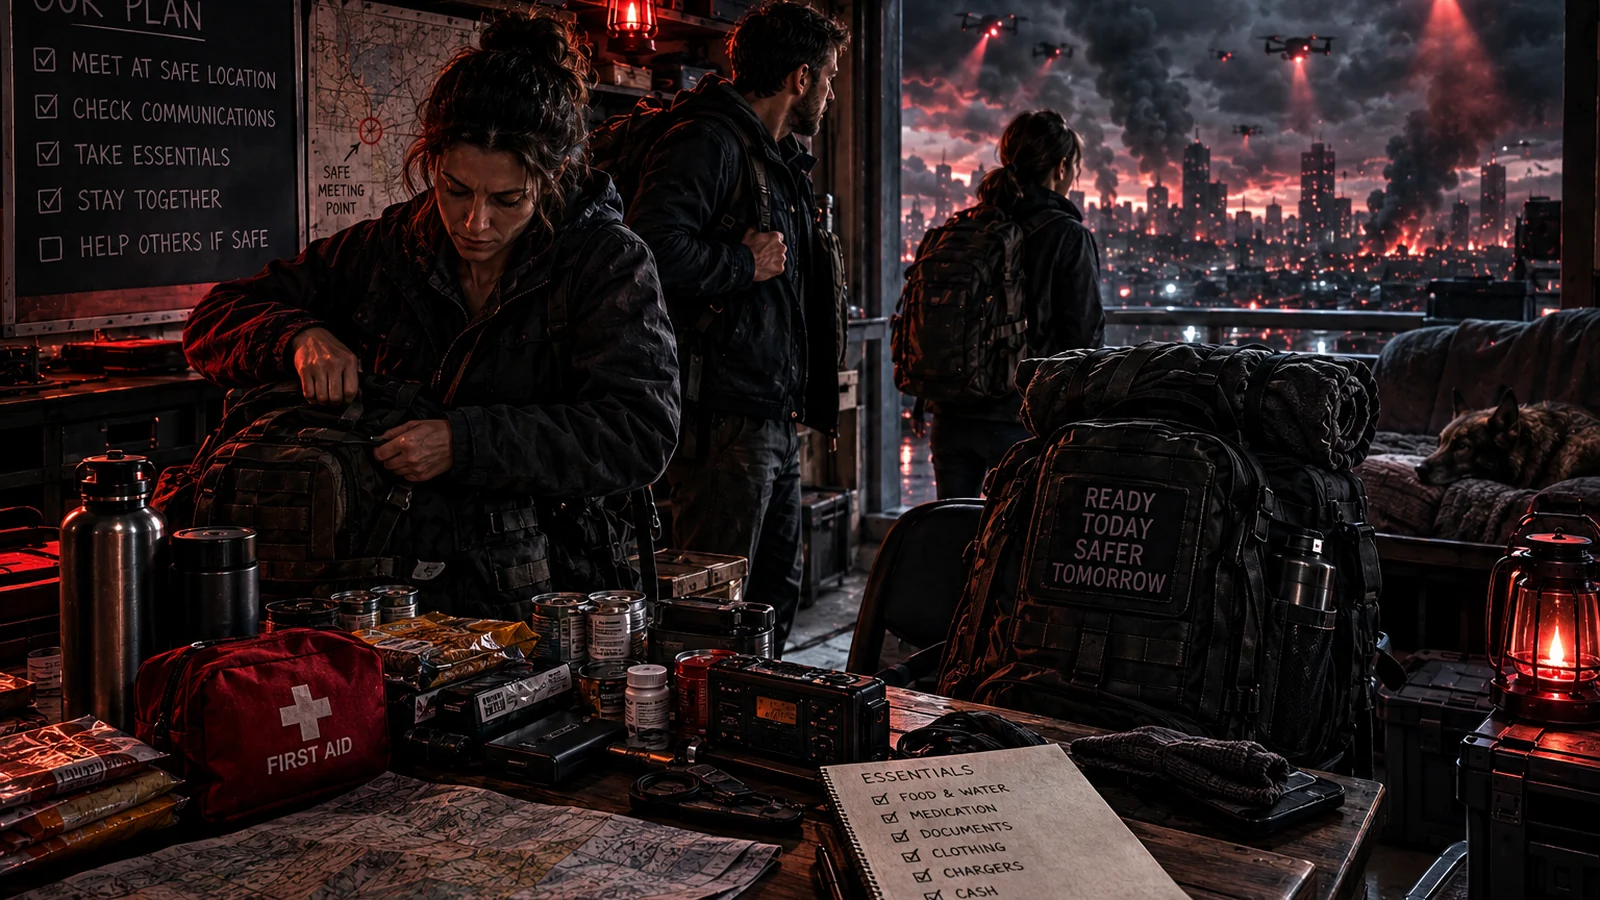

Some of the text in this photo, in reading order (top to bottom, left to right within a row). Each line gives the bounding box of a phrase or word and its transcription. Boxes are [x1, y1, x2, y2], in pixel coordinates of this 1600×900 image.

[126, 0, 201, 31] PLAN
[73, 52, 275, 89] MEET AT SAFE LOCATION
[74, 98, 275, 127] CHECK COMMUNICATIONS
[75, 144, 230, 166] TAKE ESSENTIALS
[324, 166, 350, 179] SAFE
[79, 189, 222, 210] STAY TOGETHER
[318, 184, 364, 197] MEETING
[327, 202, 356, 216] POINT
[81, 230, 268, 257] HELP OTHERS IF SAFE
[1085, 487, 1156, 513] READY
[1082, 513, 1154, 540] TODAY
[1073, 538, 1144, 566] SAFER
[1052, 562, 1167, 593] TOMORROW
[267, 736, 353, 775] FIRST AID
[860, 764, 974, 785] ESSENTIALS
[898, 783, 1010, 802] FOOD & WATER
[909, 803, 998, 820] MEDICATION
[919, 821, 1013, 839] DOCUMENTS
[931, 842, 1006, 858] CLOTHING
[943, 860, 1025, 879] CHARGERS
[955, 885, 999, 899] CASH
